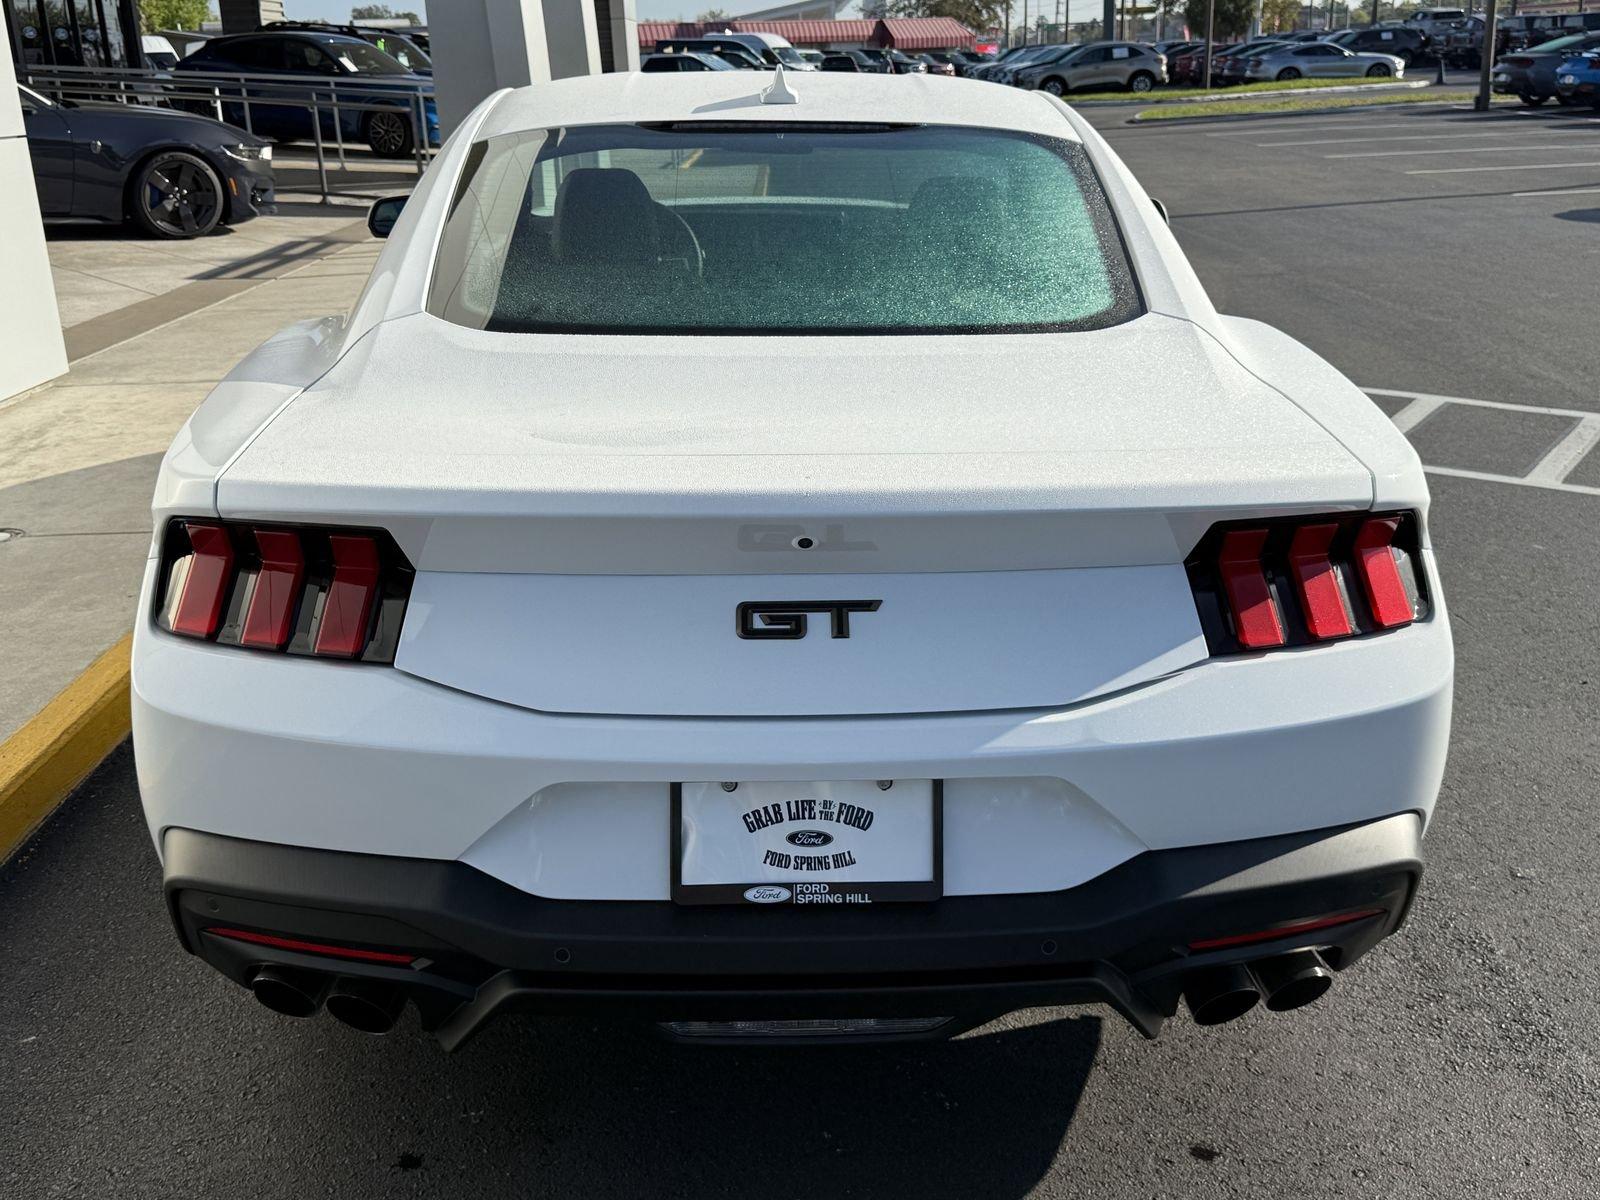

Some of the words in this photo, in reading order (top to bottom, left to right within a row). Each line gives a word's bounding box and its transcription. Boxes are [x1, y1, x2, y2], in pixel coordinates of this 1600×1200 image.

[736, 600, 883, 640] GT
[742, 802, 784, 833] GRAB
[786, 799, 816, 821] LIFE
[819, 810, 835, 821] THE
[835, 802, 874, 831] FORD
[763, 849, 791, 869] FORD
[793, 855, 831, 871] SPRING
[831, 850, 856, 869] HILL
[796, 884, 829, 893] FORD
[797, 893, 842, 904] SPRING
[846, 893, 872, 903] HILL
